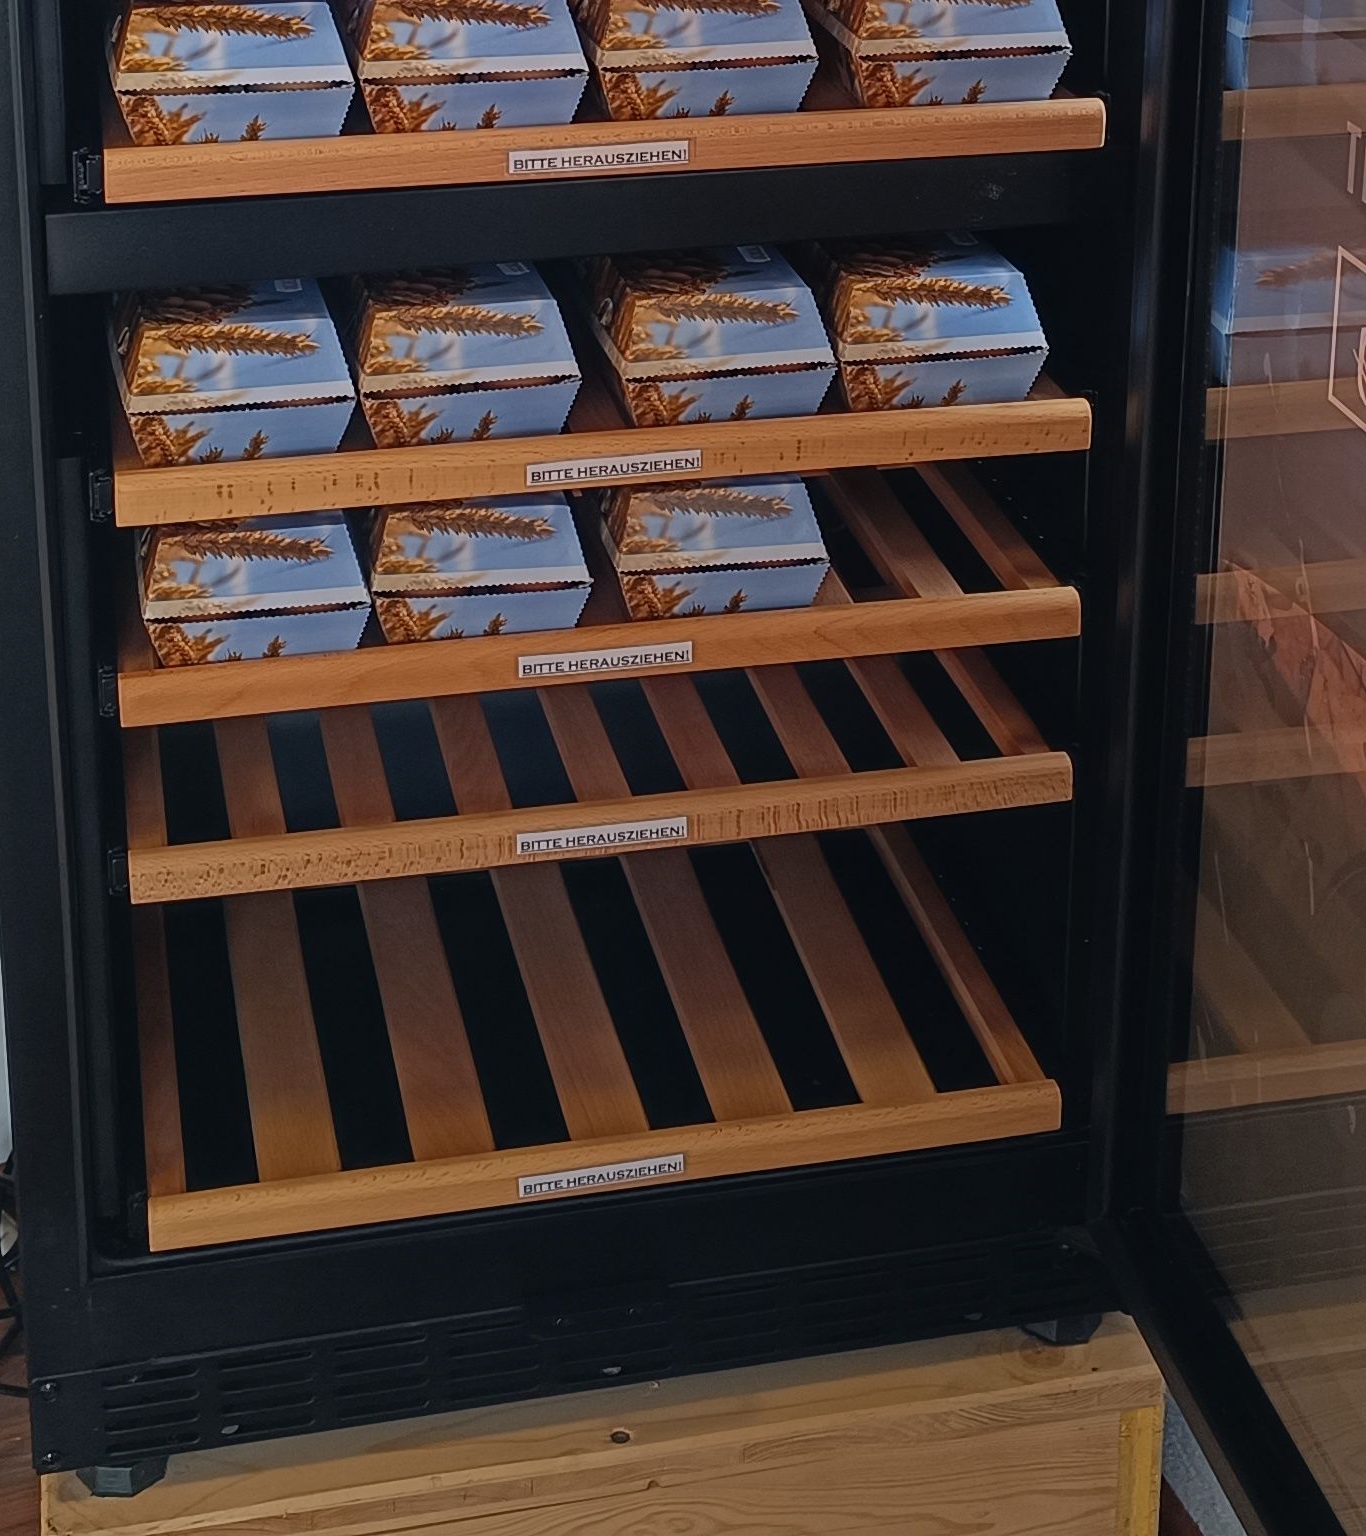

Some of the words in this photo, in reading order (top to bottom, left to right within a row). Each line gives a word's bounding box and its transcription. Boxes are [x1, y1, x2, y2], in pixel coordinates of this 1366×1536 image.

[513, 157, 558, 171] BITTE
[561, 149, 687, 168] HERAUSZIEHEN!
[531, 468, 574, 483] BITTE
[577, 456, 700, 478] HERAUSZIEHEN!
[522, 660, 565, 675] BITTE
[568, 649, 690, 671] HERAUSZIEHEN!
[520, 837, 562, 852] BITTE
[565, 825, 685, 847] HERAUSZIEHEN!
[523, 1178, 564, 1194] BITTE
[566, 1161, 683, 1187] HERAUSZIEHEN!
